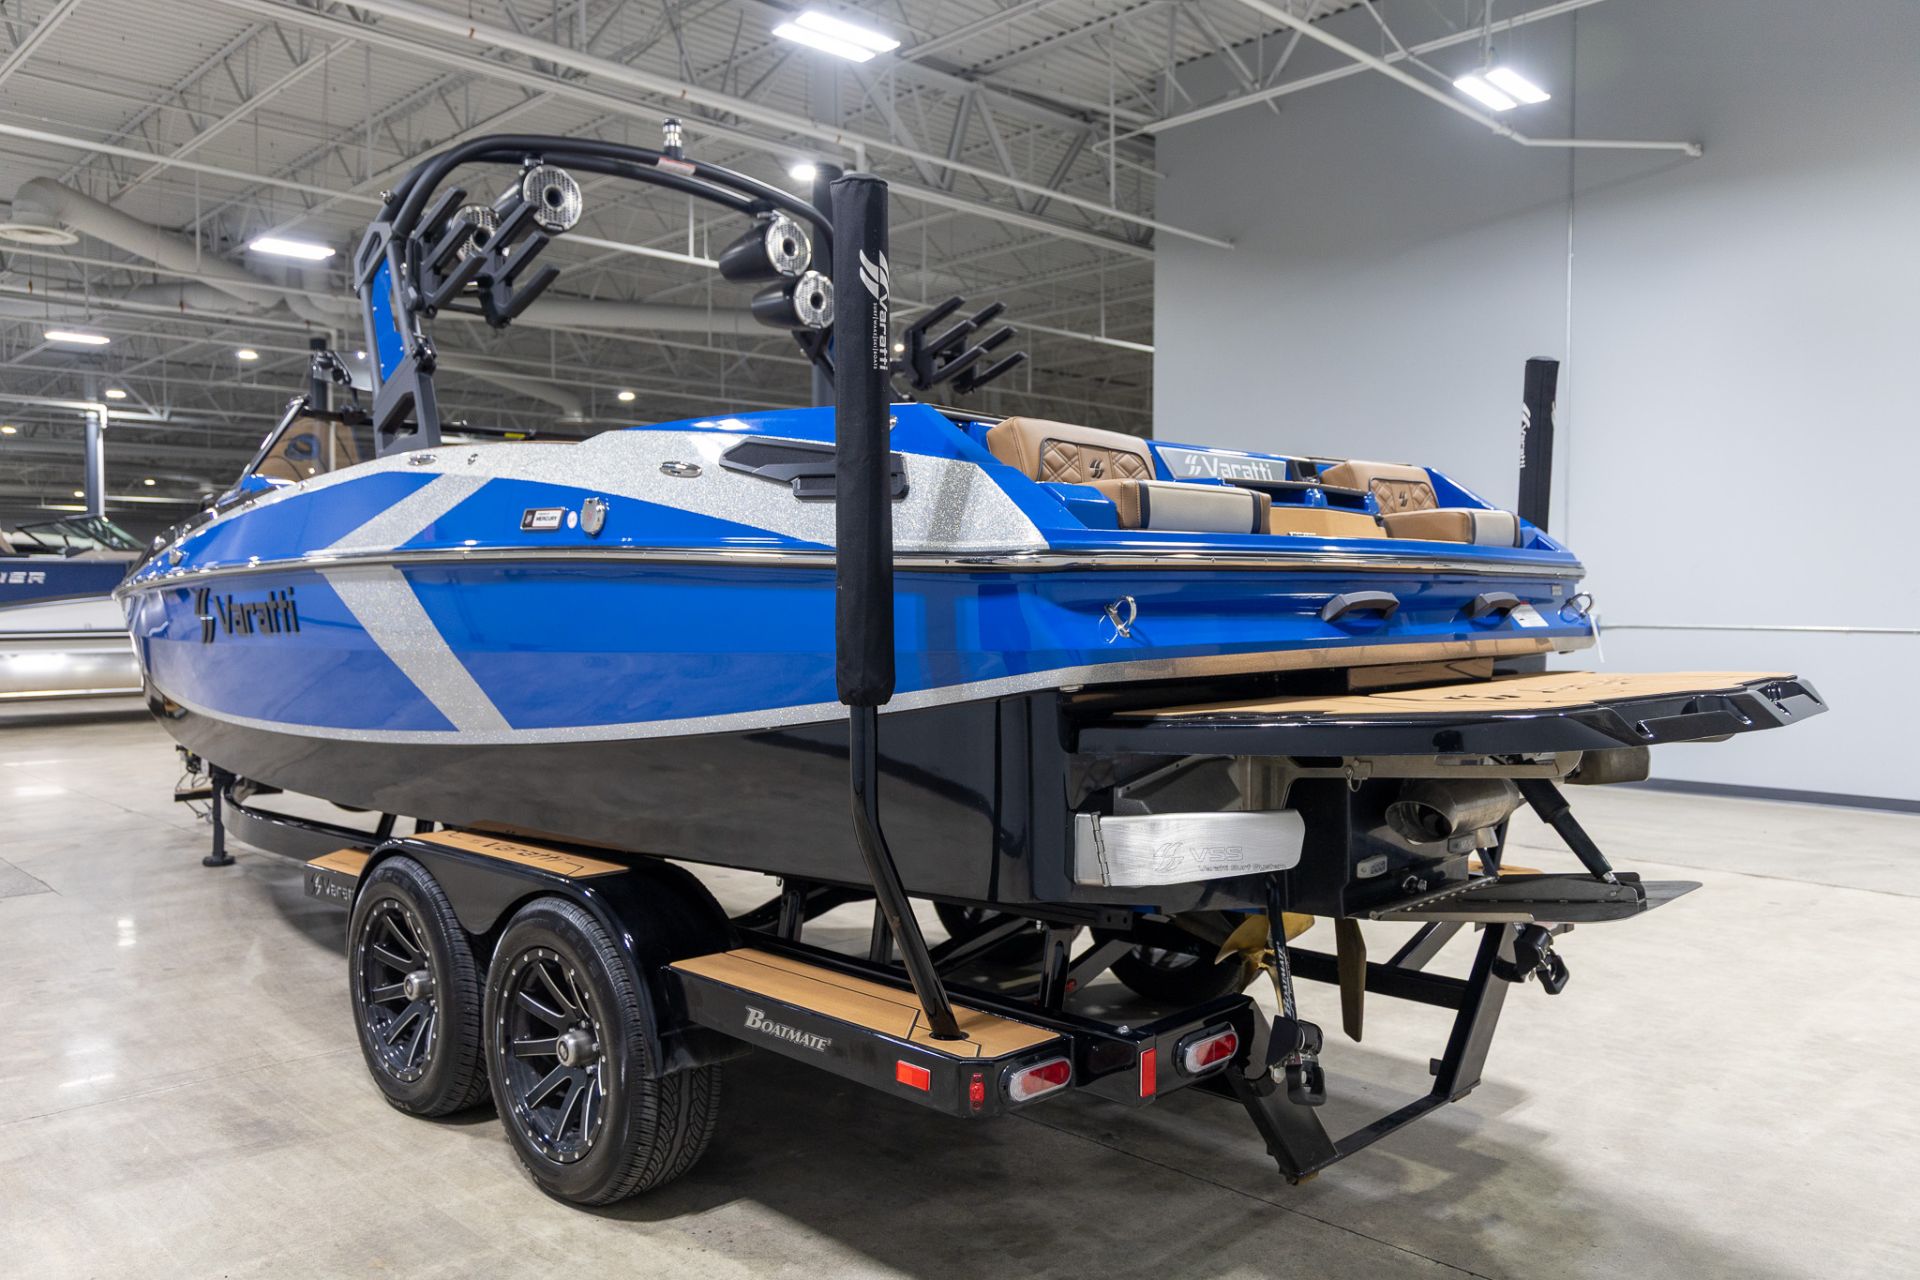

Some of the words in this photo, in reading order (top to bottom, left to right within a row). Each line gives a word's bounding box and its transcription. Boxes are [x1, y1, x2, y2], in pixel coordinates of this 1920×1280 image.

[879, 294, 888, 370] Varatti
[1201, 456, 1273, 480] Varatti
[214, 586, 300, 634] Varatti
[1189, 846, 1244, 862] VSS
